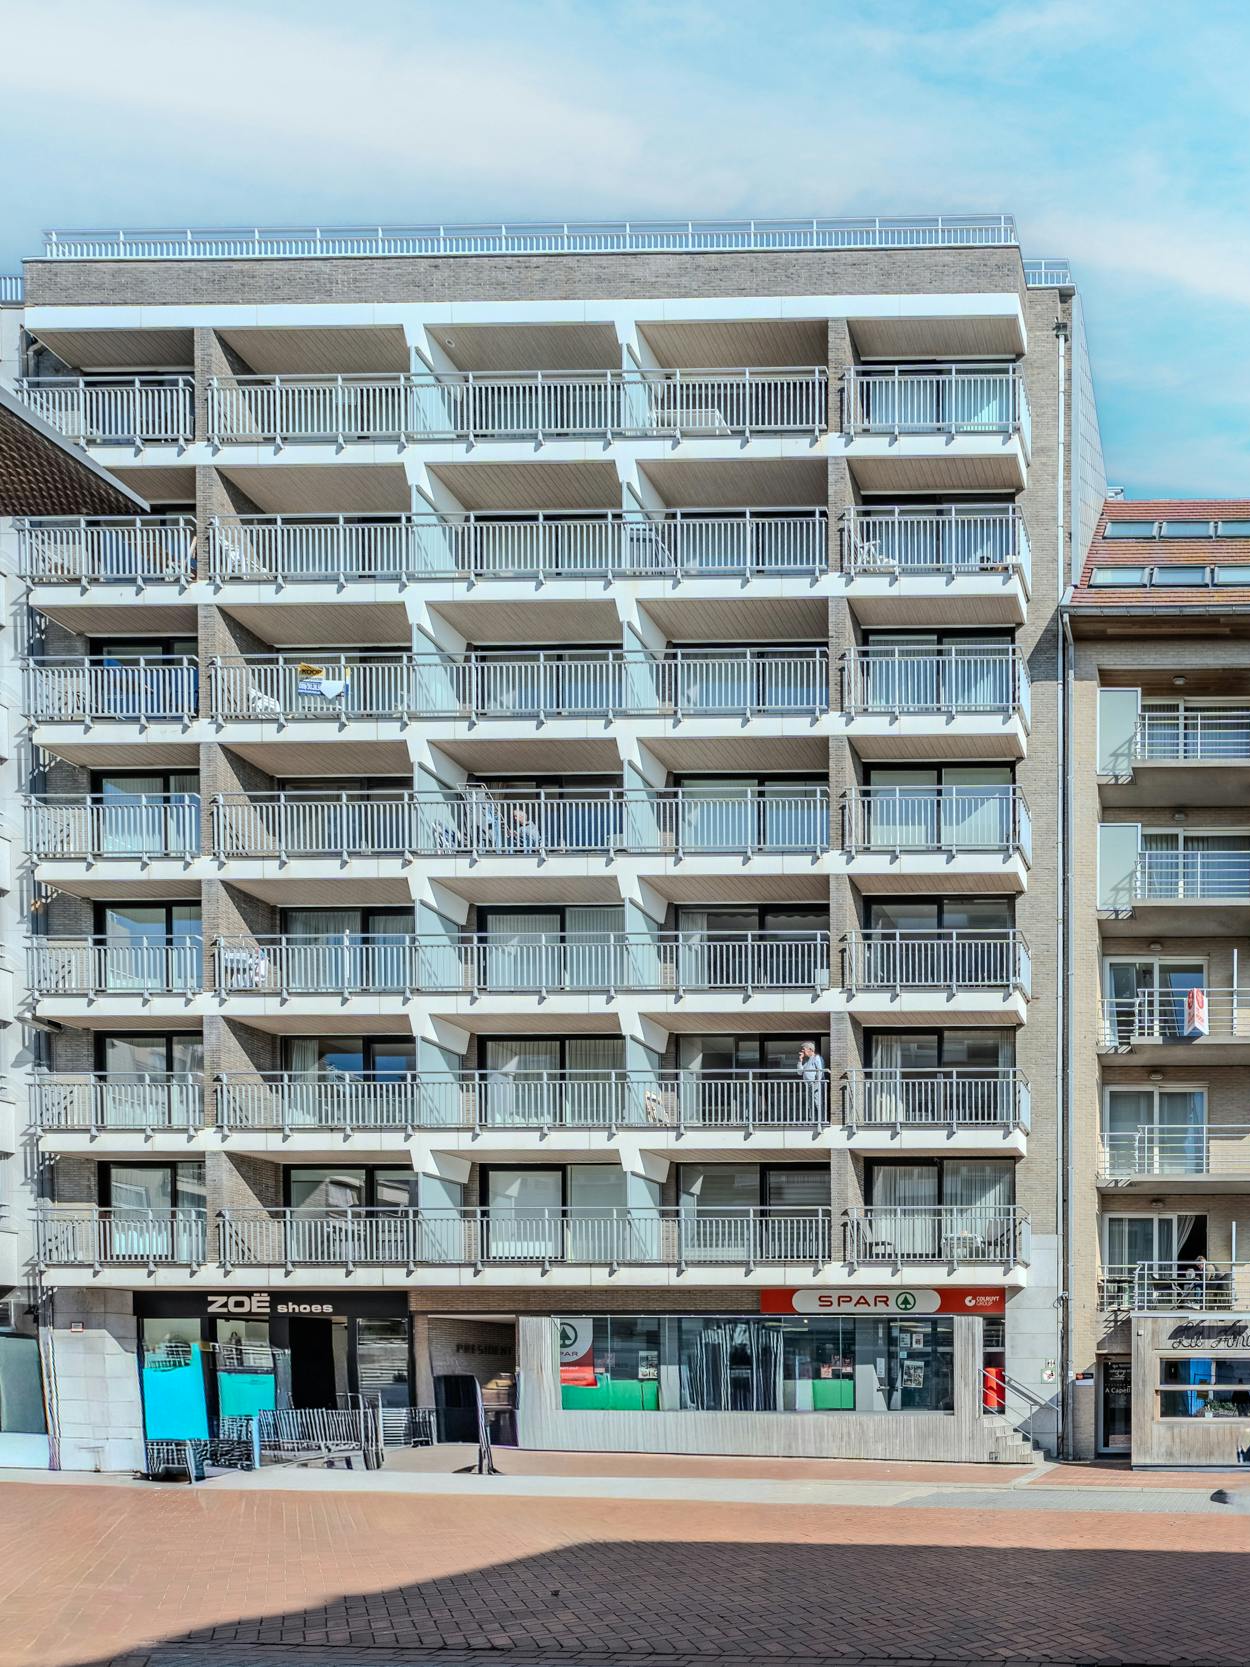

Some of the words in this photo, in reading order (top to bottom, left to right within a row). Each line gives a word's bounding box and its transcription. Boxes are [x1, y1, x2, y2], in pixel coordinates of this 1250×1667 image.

[207, 1292, 271, 1313] ZOË
[277, 1302, 333, 1313] shoes
[818, 1295, 890, 1308] SPAR
